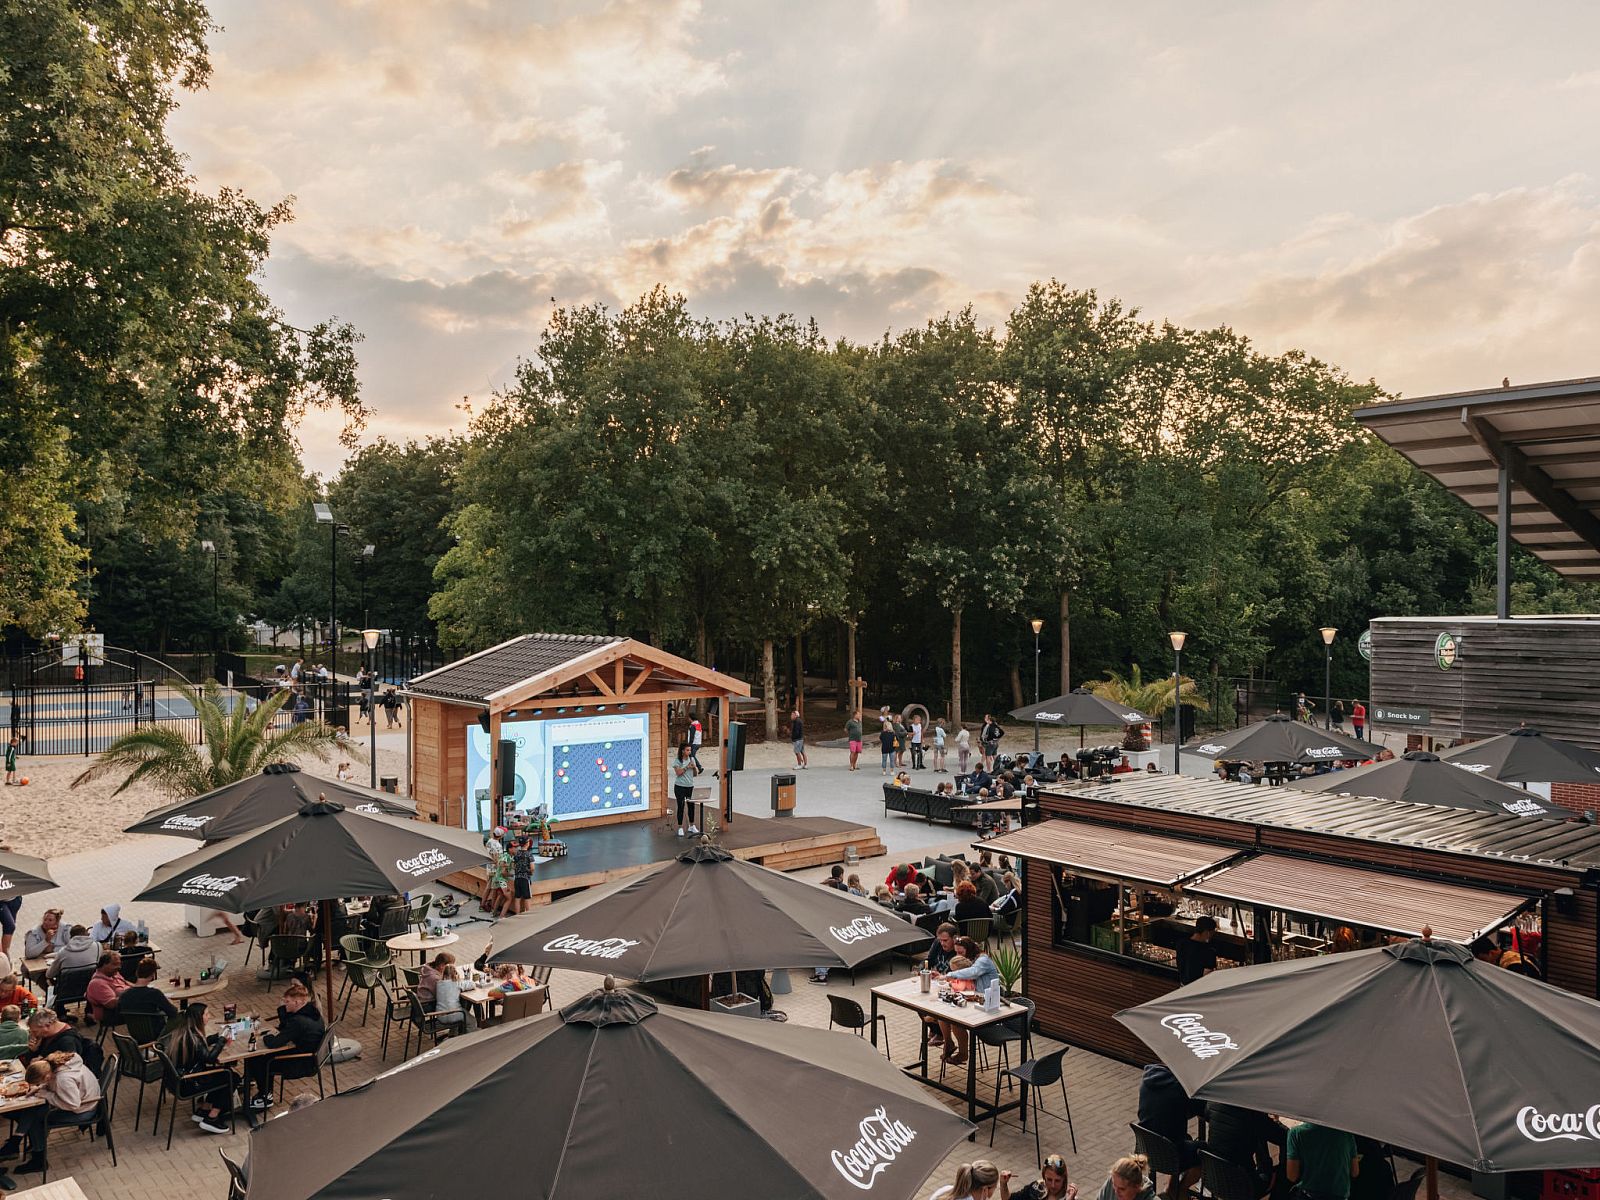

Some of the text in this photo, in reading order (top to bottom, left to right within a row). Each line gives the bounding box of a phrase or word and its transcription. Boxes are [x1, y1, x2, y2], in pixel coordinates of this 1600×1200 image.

[1387, 711, 1407, 720] Snack
[396, 848, 449, 873] Coca-Cola
[829, 915, 890, 945] Coca-Cola
[542, 933, 641, 960] Coca-Cola
[1160, 1013, 1240, 1060] Coca-Cola
[1516, 1103, 1600, 1142] Coca-C
[831, 1105, 917, 1190] Coca-Cola
